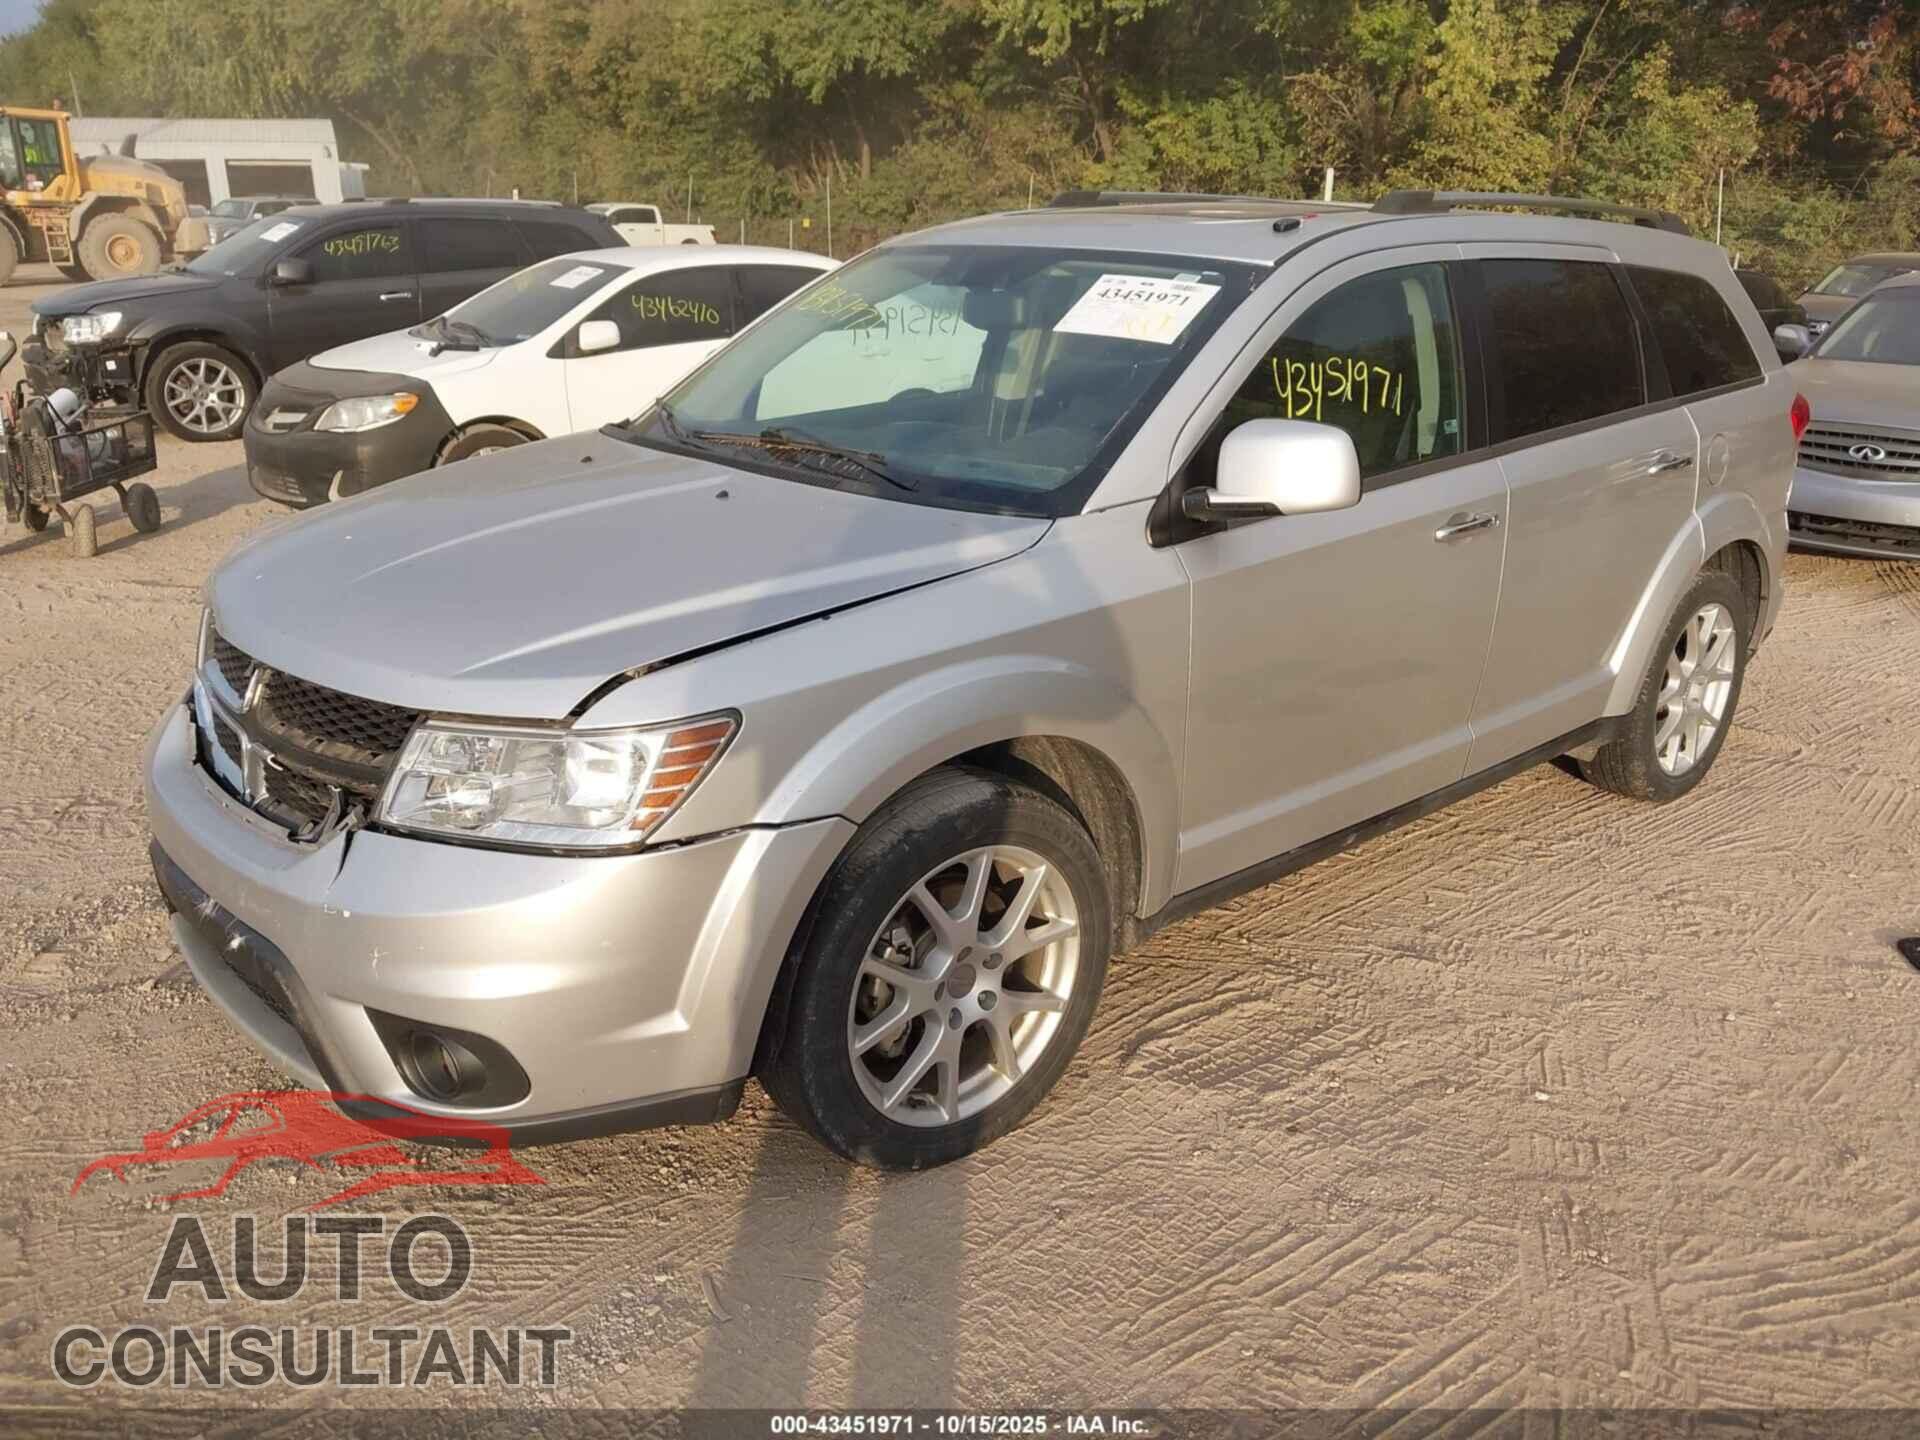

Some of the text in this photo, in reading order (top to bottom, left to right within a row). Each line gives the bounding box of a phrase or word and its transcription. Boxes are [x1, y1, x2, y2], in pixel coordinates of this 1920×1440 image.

[631, 294, 720, 325] 43462410
[1097, 286, 1192, 307] 43451971
[1272, 356, 1403, 422] 43451971
